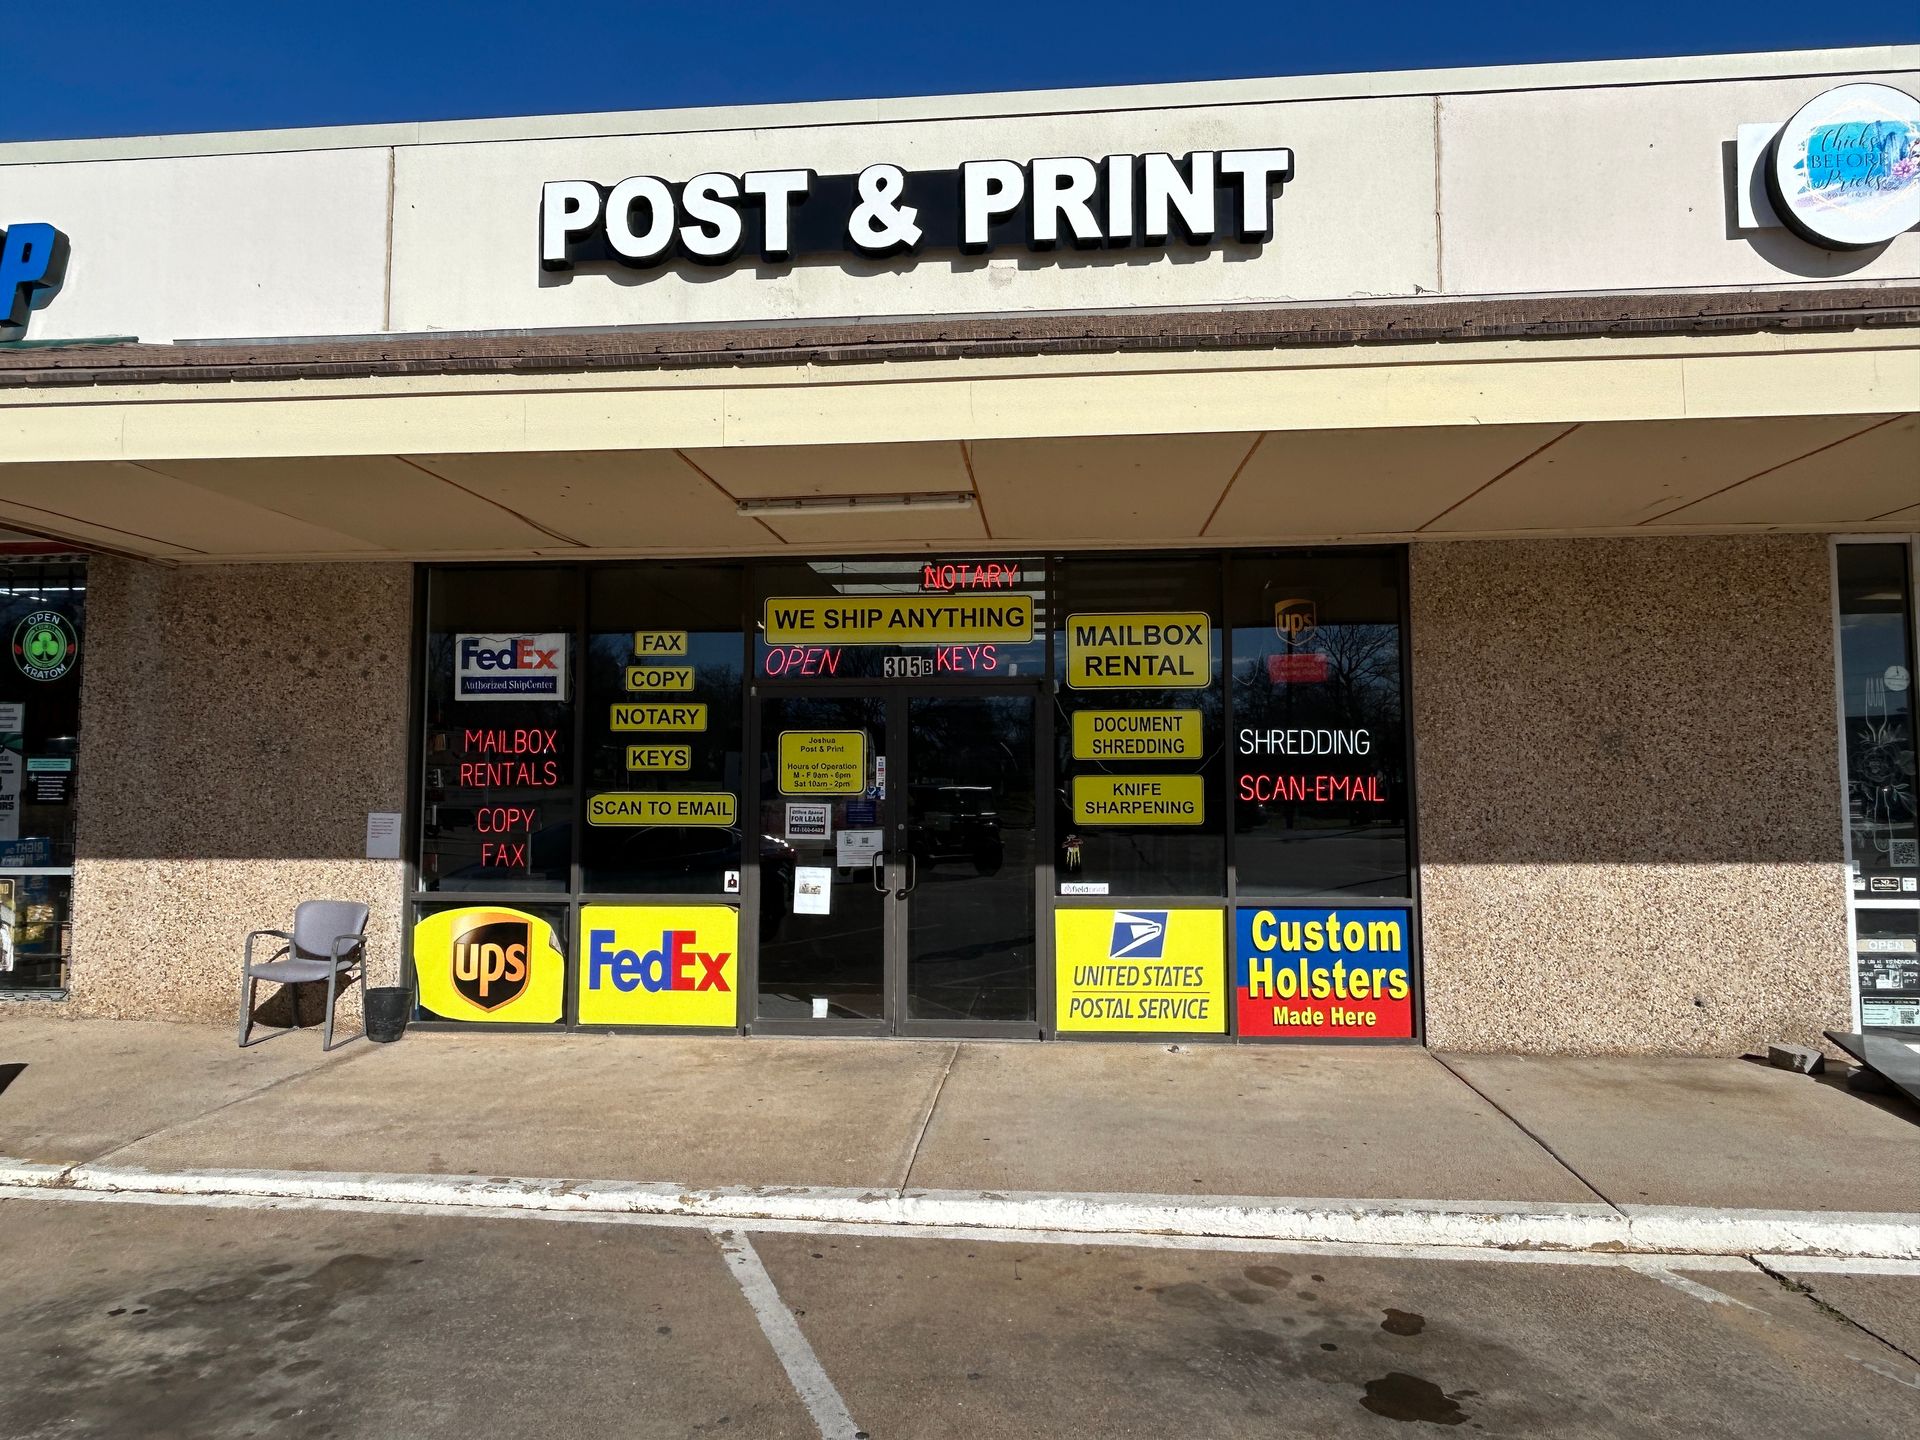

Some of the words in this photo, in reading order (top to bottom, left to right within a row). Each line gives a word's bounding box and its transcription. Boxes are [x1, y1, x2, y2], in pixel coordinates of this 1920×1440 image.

[1821, 123, 1879, 152] Chicks
[543, 169, 810, 261] POST
[848, 163, 923, 249] &
[962, 148, 1291, 243] PRINT
[923, 564, 1018, 590] NOTARY
[28, 613, 60, 624] OPEN
[775, 609, 815, 629] WE
[823, 608, 883, 629] SHIP
[888, 607, 1025, 629] ANYTHING
[1278, 613, 1313, 640] ups
[642, 635, 682, 651] FAX
[1076, 624, 1203, 647] MAILBOX
[461, 638, 560, 671] FedEx
[765, 648, 842, 676] OPEN
[937, 645, 998, 671] KEYS
[23, 663, 67, 679] KRATOM
[1085, 655, 1195, 677] RENTAL
[464, 681, 507, 690] Authorized
[631, 671, 690, 688] COPY
[615, 708, 700, 726] NOTARY
[1094, 716, 1183, 732] DOCUMENT
[464, 729, 557, 754] MAILBOX
[1092, 739, 1185, 754] SHREDDING
[1239, 728, 1371, 755] SHREDDING
[631, 749, 688, 766] KEYS
[820, 763, 857, 771] Operation
[460, 761, 557, 788] RENTALS
[834, 780, 851, 789] 2pm
[1112, 782, 1162, 796] KNIFE
[1239, 774, 1385, 802] SCAN-EMAIL
[592, 801, 642, 816] SCAN
[649, 801, 672, 816] TO
[677, 800, 733, 816] EMAIL
[1085, 801, 1195, 814] SHARPENING
[477, 808, 535, 833] COPY
[481, 843, 525, 867] FAX
[1251, 909, 1402, 953] Custom
[1868, 940, 1905, 950] OPEN
[455, 942, 526, 998] ups
[588, 929, 732, 993] FedEx
[1073, 965, 1140, 986] UNITED
[1142, 966, 1204, 987] STATES
[1248, 956, 1409, 1000] Holsters
[1069, 997, 1134, 1019] POSTAL
[1137, 998, 1210, 1020] SERVICE
[1273, 1006, 1324, 1026] Made
[1331, 1006, 1376, 1026] Here
